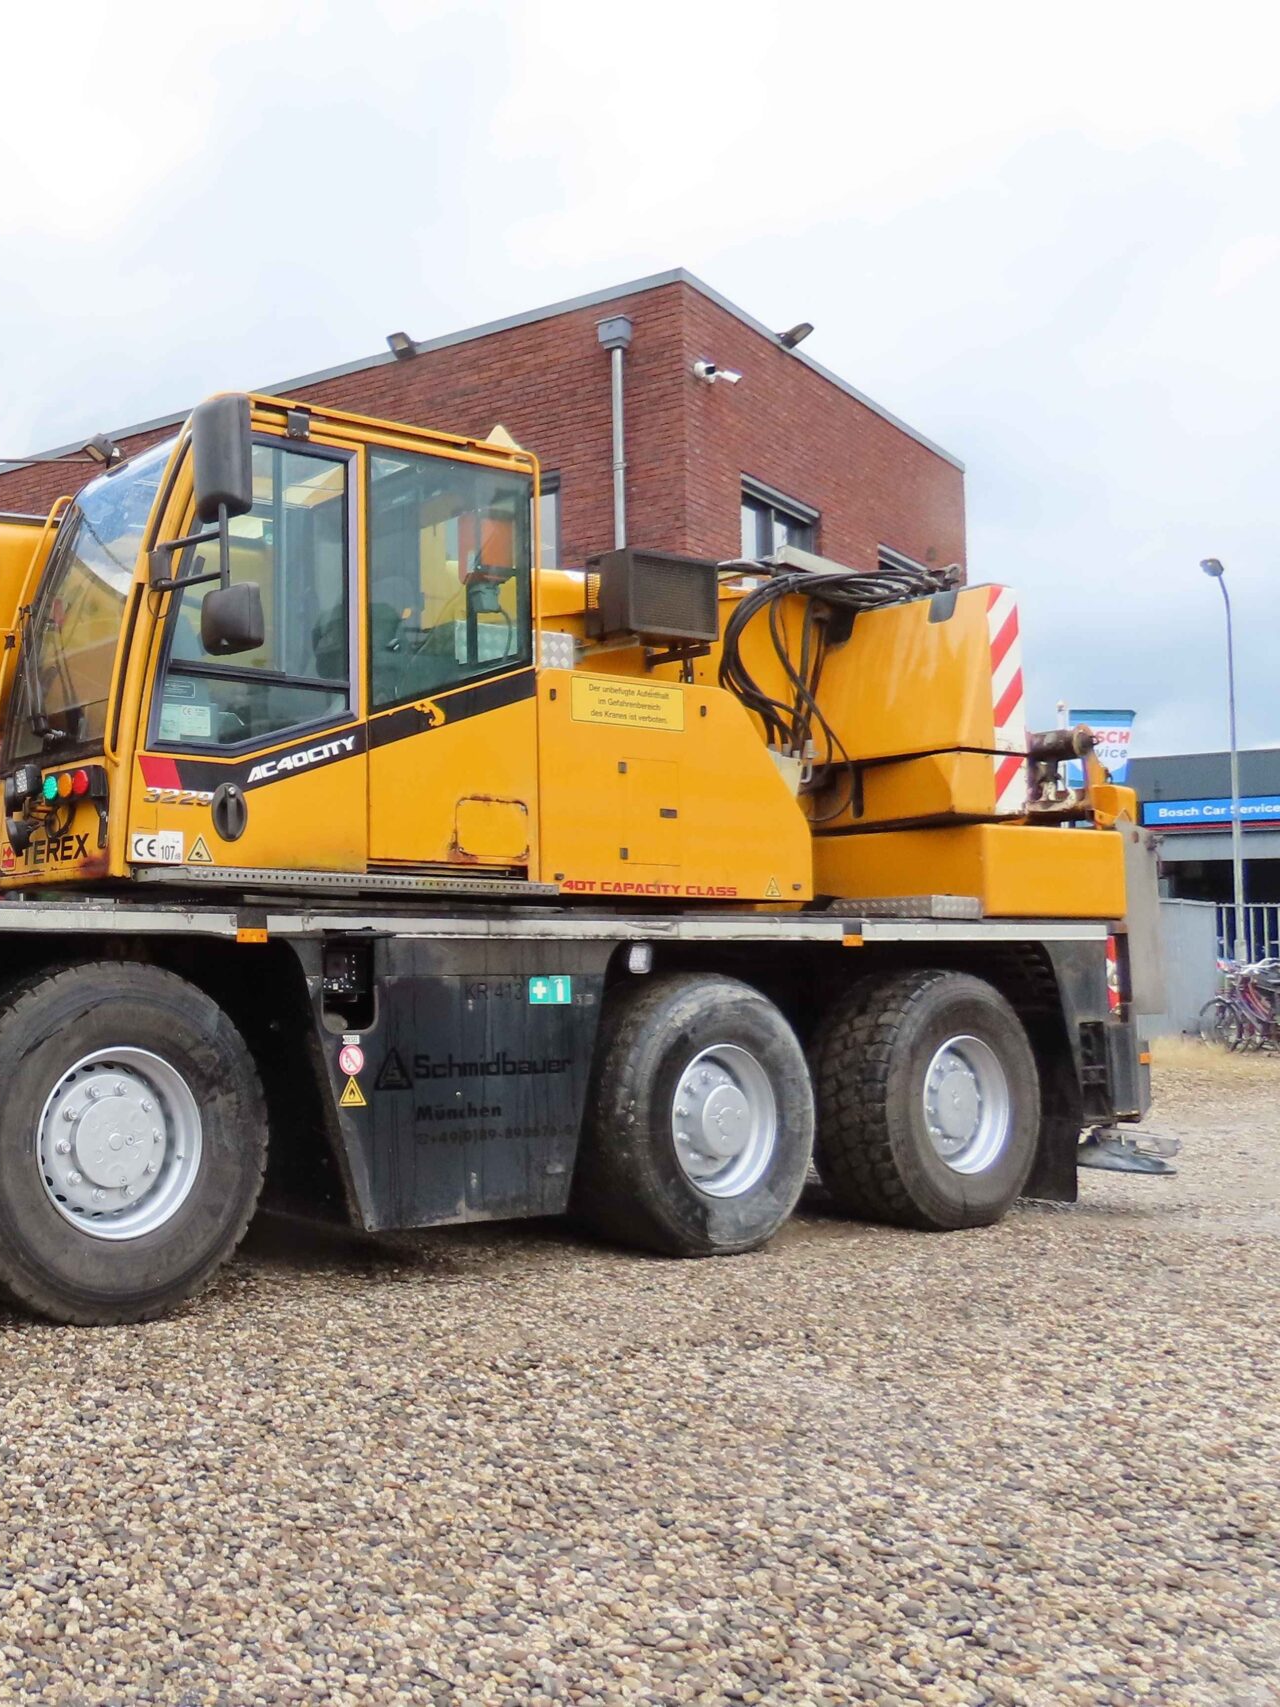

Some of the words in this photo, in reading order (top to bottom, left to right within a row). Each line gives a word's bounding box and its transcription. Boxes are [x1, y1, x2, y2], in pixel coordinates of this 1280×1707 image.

[588, 683, 601, 692] Der
[602, 686, 636, 697] unbefugte
[607, 698, 661, 711] Gefahrenbereich
[590, 708, 603, 717] des
[629, 713, 638, 721] ist
[1094, 730, 1130, 744] SCH
[1095, 746, 1128, 758] vice
[143, 787, 215, 807] 3229
[1158, 806, 1199, 818] Bosch
[1202, 805, 1227, 816] Car
[160, 845, 176, 860] 107
[562, 880, 596, 892] 40T
[600, 881, 681, 896] CAPACITY
[685, 885, 738, 897] CLASS
[413, 1051, 573, 1080] Schmidbauer
[415, 1101, 502, 1121] München
